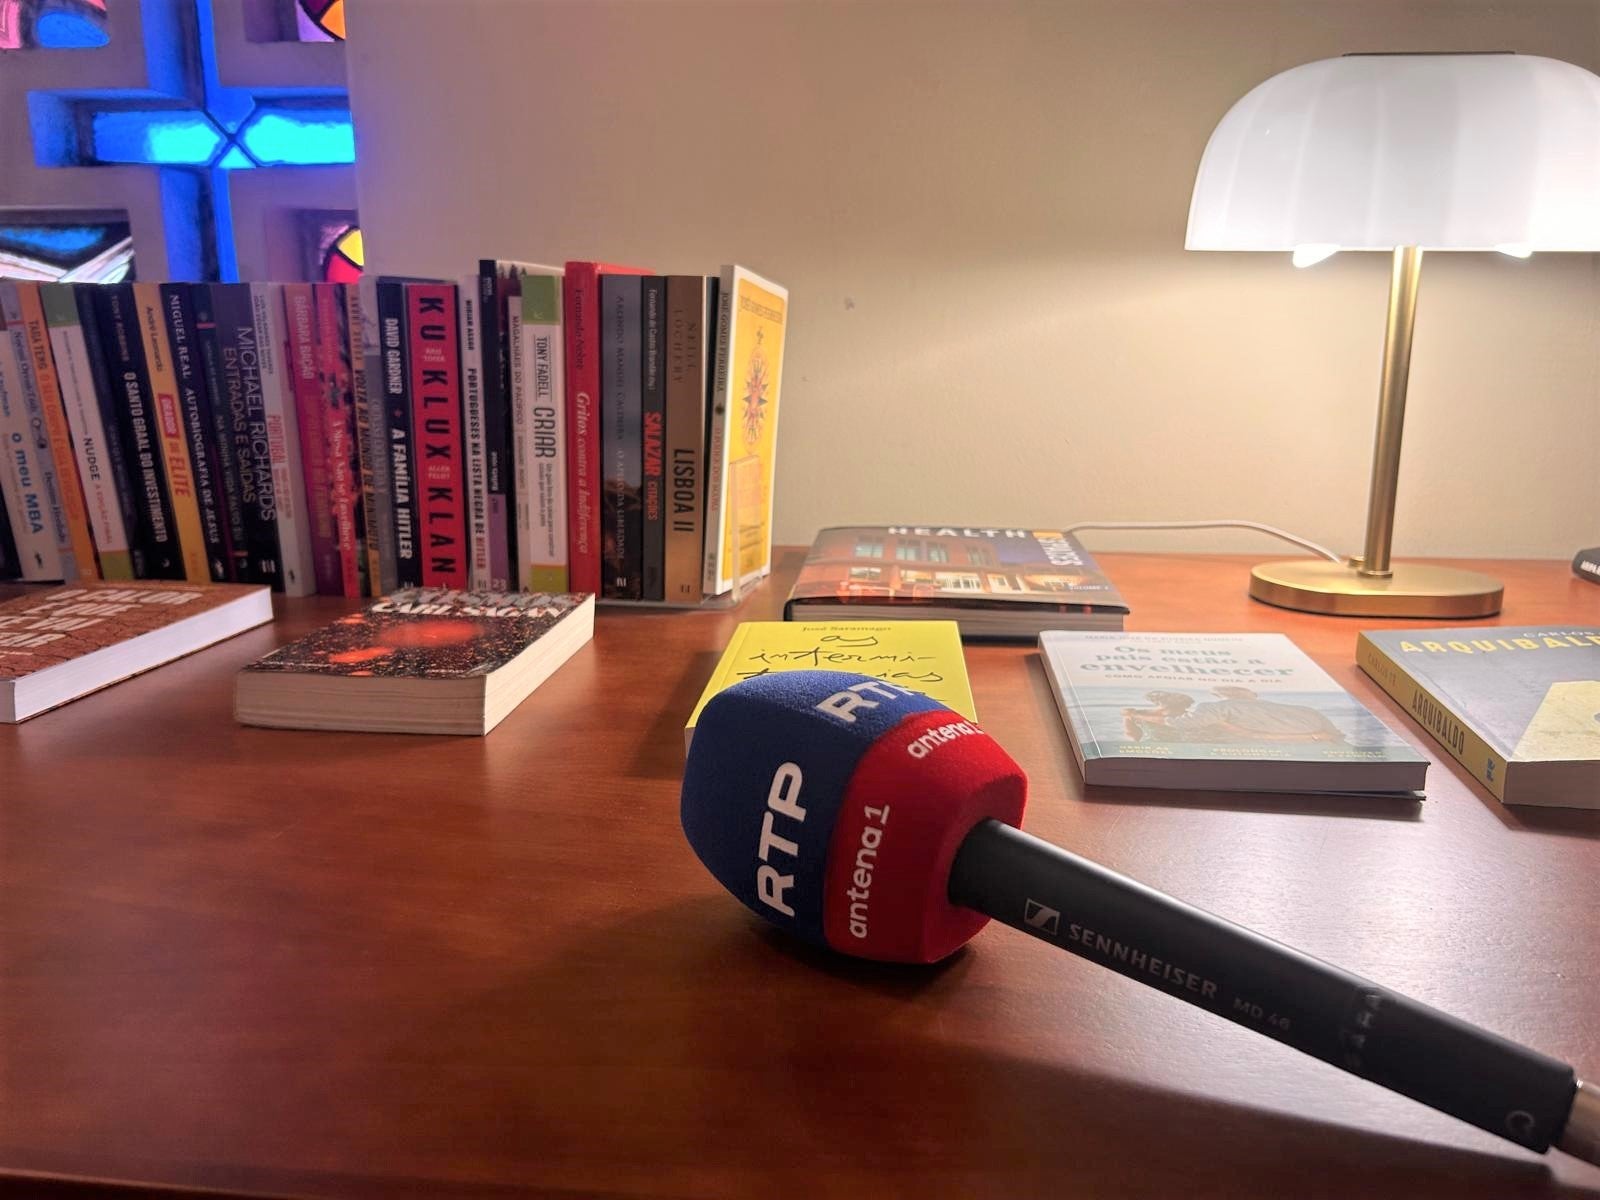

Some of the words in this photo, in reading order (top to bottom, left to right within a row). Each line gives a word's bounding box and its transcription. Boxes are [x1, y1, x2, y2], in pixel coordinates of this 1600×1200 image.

[146, 306, 158, 332] André
[294, 296, 311, 344] BÁRBARA
[420, 297, 446, 340] KU
[648, 289, 658, 319] Fernando
[720, 292, 729, 313] JOSÉ
[170, 295, 186, 343] MIGUEL
[178, 346, 191, 378] REAL
[385, 318, 400, 347] DAVID
[719, 314, 728, 345] GOMES
[151, 333, 163, 373] Leonardo
[536, 337, 548, 361] TONY
[576, 337, 587, 370] Nobre
[124, 372, 136, 380] O
[223, 347, 248, 432] ENTRADAS
[237, 327, 264, 417] MICHAEL
[354, 370, 368, 405] VOLTA
[388, 350, 403, 394] GARDNER
[538, 364, 549, 398] FADELL
[125, 382, 144, 416] SANTO
[359, 407, 371, 423] AO
[422, 370, 451, 458] KLUX
[468, 368, 480, 440] PORTUGUESES
[576, 391, 591, 436] Gritos
[12, 432, 23, 443] o
[134, 418, 151, 451] GRAAL
[184, 388, 209, 487] AUTOBIOGRAFIA
[235, 435, 248, 444] E
[267, 415, 286, 464] PORTUGAL
[361, 427, 374, 469] MUNDO
[392, 428, 405, 439] A
[471, 442, 481, 456] NA
[533, 407, 556, 458] CRIAR
[644, 412, 661, 476] SALAZAR
[15, 450, 32, 487] meu
[84, 437, 100, 480] NUDGE
[140, 453, 154, 467] DO
[250, 421, 277, 521] RICHARDS
[393, 444, 412, 504] FAMÍLIA
[472, 459, 484, 486] LISTA
[577, 438, 588, 476] contra
[169, 457, 191, 498] ELITE
[237, 449, 257, 503] SAÍDAS
[364, 474, 376, 490] DE
[673, 448, 695, 514] LISBOA
[25, 493, 44, 534] MBA
[144, 469, 169, 543] INVESTIMENTO
[203, 489, 214, 504] DE
[473, 488, 484, 520] NEGRA
[646, 481, 658, 521] CITAÇÕES
[207, 508, 220, 543] JESUS
[397, 508, 413, 559] HITLER
[428, 487, 456, 573] KLAN
[475, 522, 485, 534] DE
[577, 489, 591, 554] Indiferença
[673, 521, 695, 532] II
[888, 527, 1026, 538] HEALTH
[476, 537, 486, 569] HITLER
[51, 603, 143, 616] QUE
[76, 589, 203, 605] CALOR
[372, 602, 452, 615] CARL
[455, 605, 568, 618] SAGAN
[1080, 663, 1294, 676] envelhecer
[1096, 654, 1152, 662] pais
[1161, 656, 1238, 665] estão
[1114, 646, 1151, 654] Os
[1159, 648, 1232, 656] meus
[907, 720, 973, 759] antena
[1411, 689, 1466, 756] ARQUIBALDO
[757, 761, 807, 917] RTP
[847, 827, 883, 939] antena
[865, 804, 890, 825] 1
[1068, 923, 1218, 1000] SENNHEISER
[1232, 996, 1263, 1019] MD
